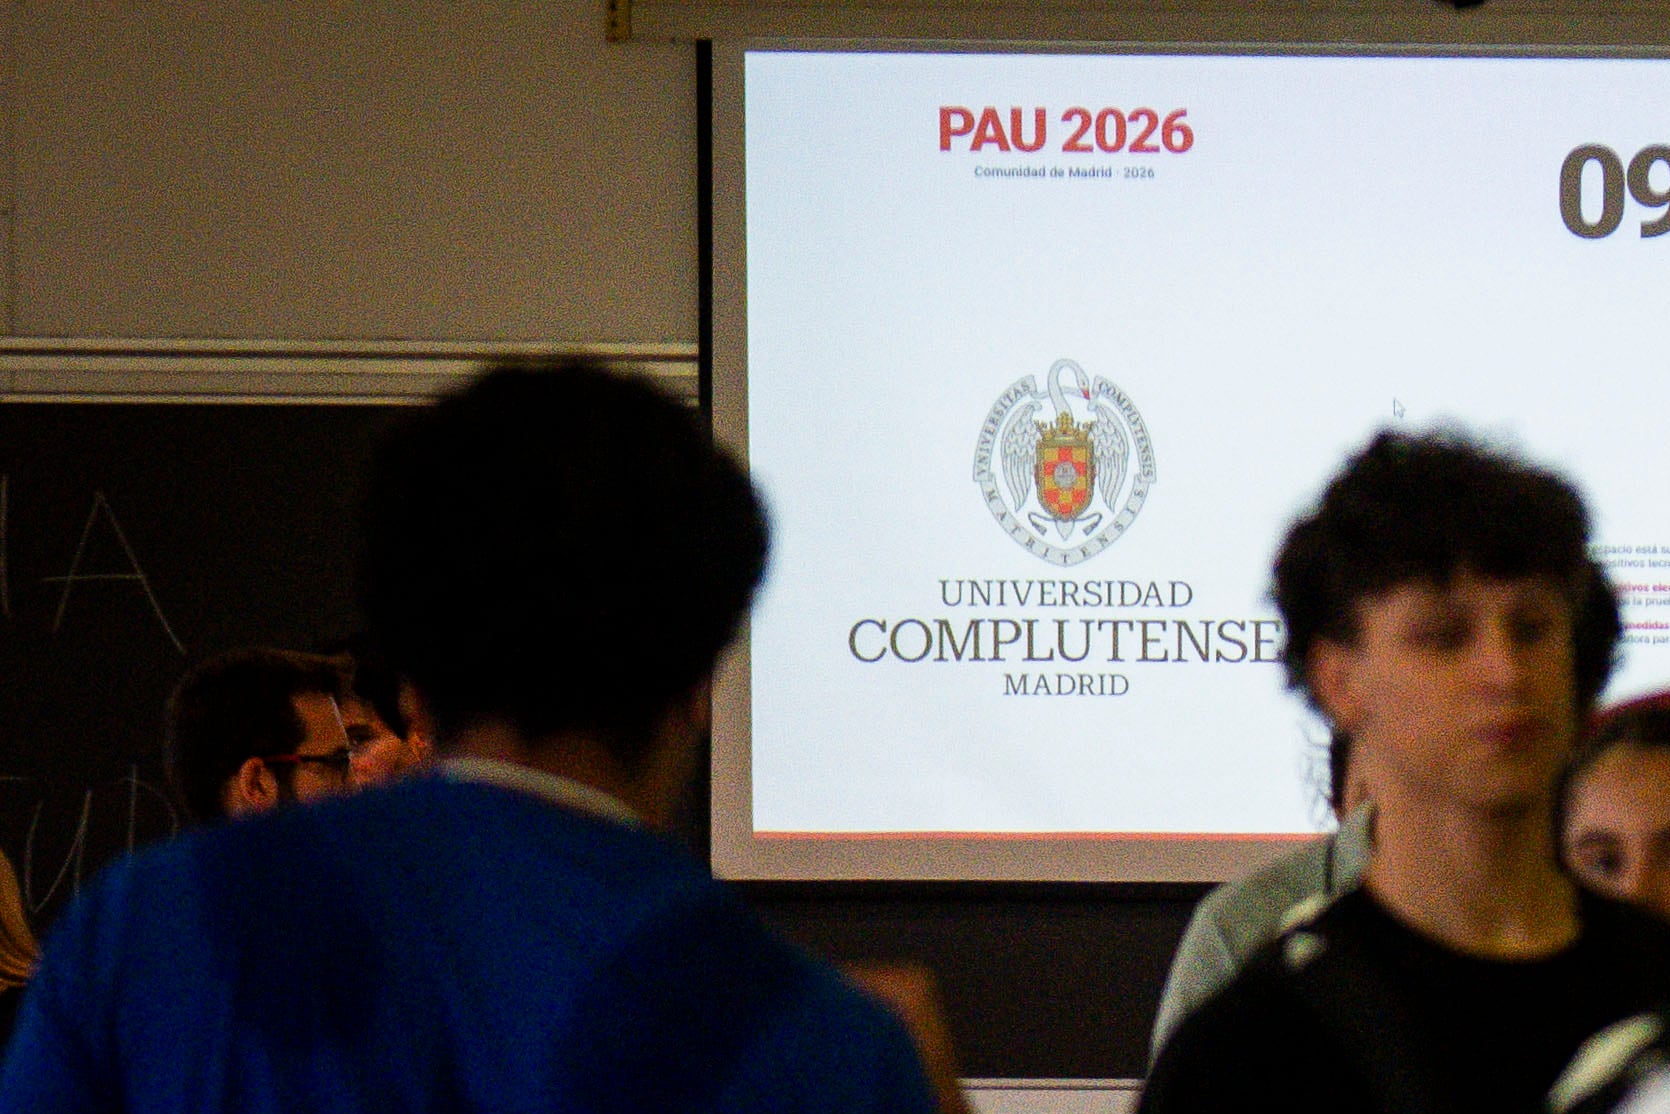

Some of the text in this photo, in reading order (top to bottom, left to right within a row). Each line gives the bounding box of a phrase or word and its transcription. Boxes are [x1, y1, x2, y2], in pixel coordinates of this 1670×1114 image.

[939, 106, 1194, 154] PAU 2026
[974, 165, 1155, 178] Comunidad de Madrid 2026
[939, 579, 1193, 607] UNIVERSIDAD
[848, 618, 1285, 664] COMPLUTENSE
[1003, 672, 1130, 697] MADRID
